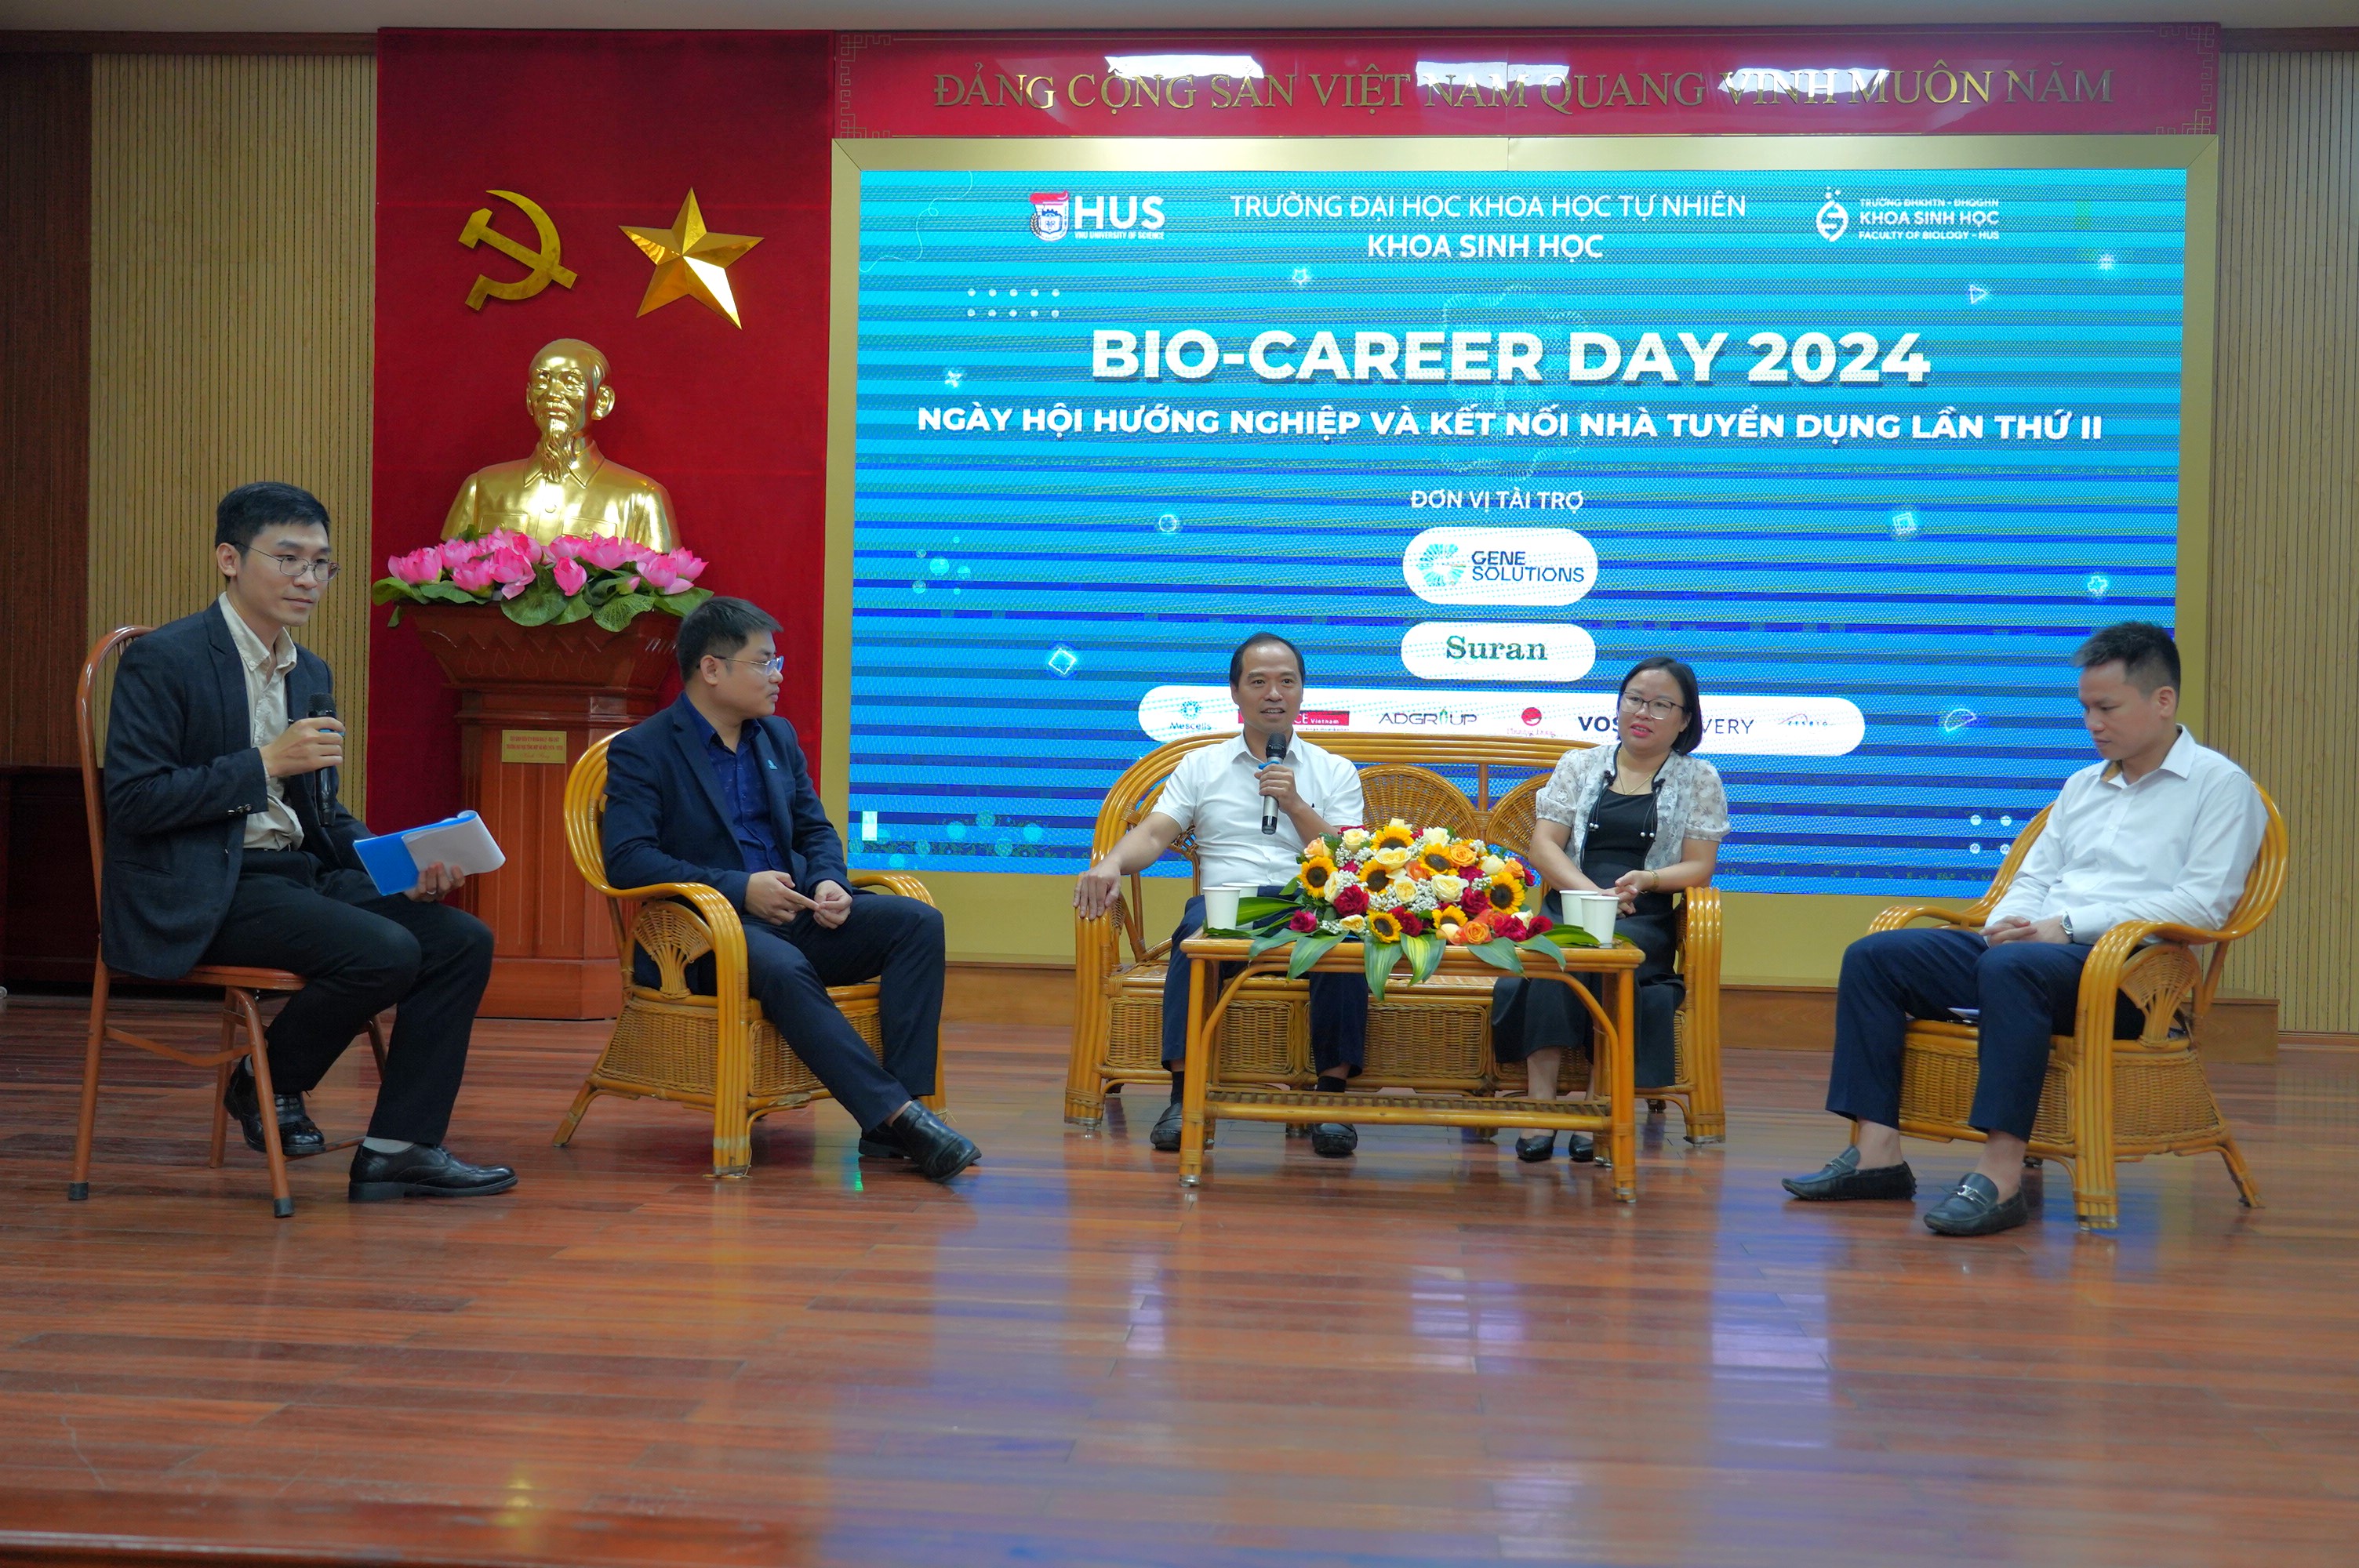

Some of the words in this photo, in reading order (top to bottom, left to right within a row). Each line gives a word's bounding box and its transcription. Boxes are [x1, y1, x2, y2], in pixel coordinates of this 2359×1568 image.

[934, 62, 1056, 109] ĐẢNG
[1068, 64, 1198, 115] CỘNG
[1308, 63, 1411, 115] VIỆT
[1423, 73, 1529, 107] NAM
[1540, 72, 1705, 115] QUANG
[1719, 70, 1837, 105] VINH
[1848, 59, 1994, 104] MUÔN
[2003, 60, 2115, 103] NĂM
[1074, 195, 1166, 230] HUS
[1230, 191, 1343, 217] TRƯỜNG
[1350, 195, 1394, 221] ĐẠI
[1403, 195, 1461, 222] HỌC
[1470, 195, 1544, 217] KHOA
[1552, 195, 1612, 222] HỌC
[1617, 194, 1657, 222] TỰ
[1663, 190, 1746, 217] NHIÊN
[1860, 211, 1910, 225] KHOA
[1914, 211, 1955, 225] SINH
[1960, 211, 1999, 228] HỌC
[1074, 231, 1088, 240] VNU
[1089, 231, 1128, 240] UNIVERSITY
[1128, 231, 1136, 240] OF
[1138, 231, 1165, 240] SCIENCE
[1368, 234, 1452, 258] KHOA
[1459, 234, 1528, 259] SINH
[1539, 234, 1605, 263] HỌC
[1859, 231, 1904, 240] FACULTY
[1905, 231, 1921, 240] OF
[1923, 231, 1968, 240] BIOLOGY
[1979, 231, 1999, 240] HUS
[1092, 329, 1543, 382] BIO-CAREER
[1569, 332, 1729, 383] DAY
[1747, 332, 1932, 383] 2024
[918, 401, 1012, 431] NGÀY
[1023, 403, 1082, 439] HỘI
[1094, 404, 1219, 434] HƯỚNG
[1230, 405, 1361, 441] NGHIỆP
[1370, 405, 1420, 435] VÀ
[1430, 403, 1498, 436] KẾT
[1506, 404, 1568, 437] NỐI
[1580, 407, 1658, 437] NHÀ
[1667, 404, 1785, 438] TUYỂN
[1796, 414, 1901, 445] DỤNG
[1911, 406, 1984, 439] LẦN
[1994, 408, 2074, 440] THỨ
[2081, 416, 2102, 440] II
[1410, 488, 1463, 509] ĐƠN
[1469, 491, 1489, 513] VỊ
[1496, 486, 1531, 510] TÀI
[1537, 490, 1584, 514] TRỢ
[1471, 551, 1526, 565] GENE
[1472, 566, 1585, 583] SOLUTIONS
[1446, 635, 1548, 660] Suran
